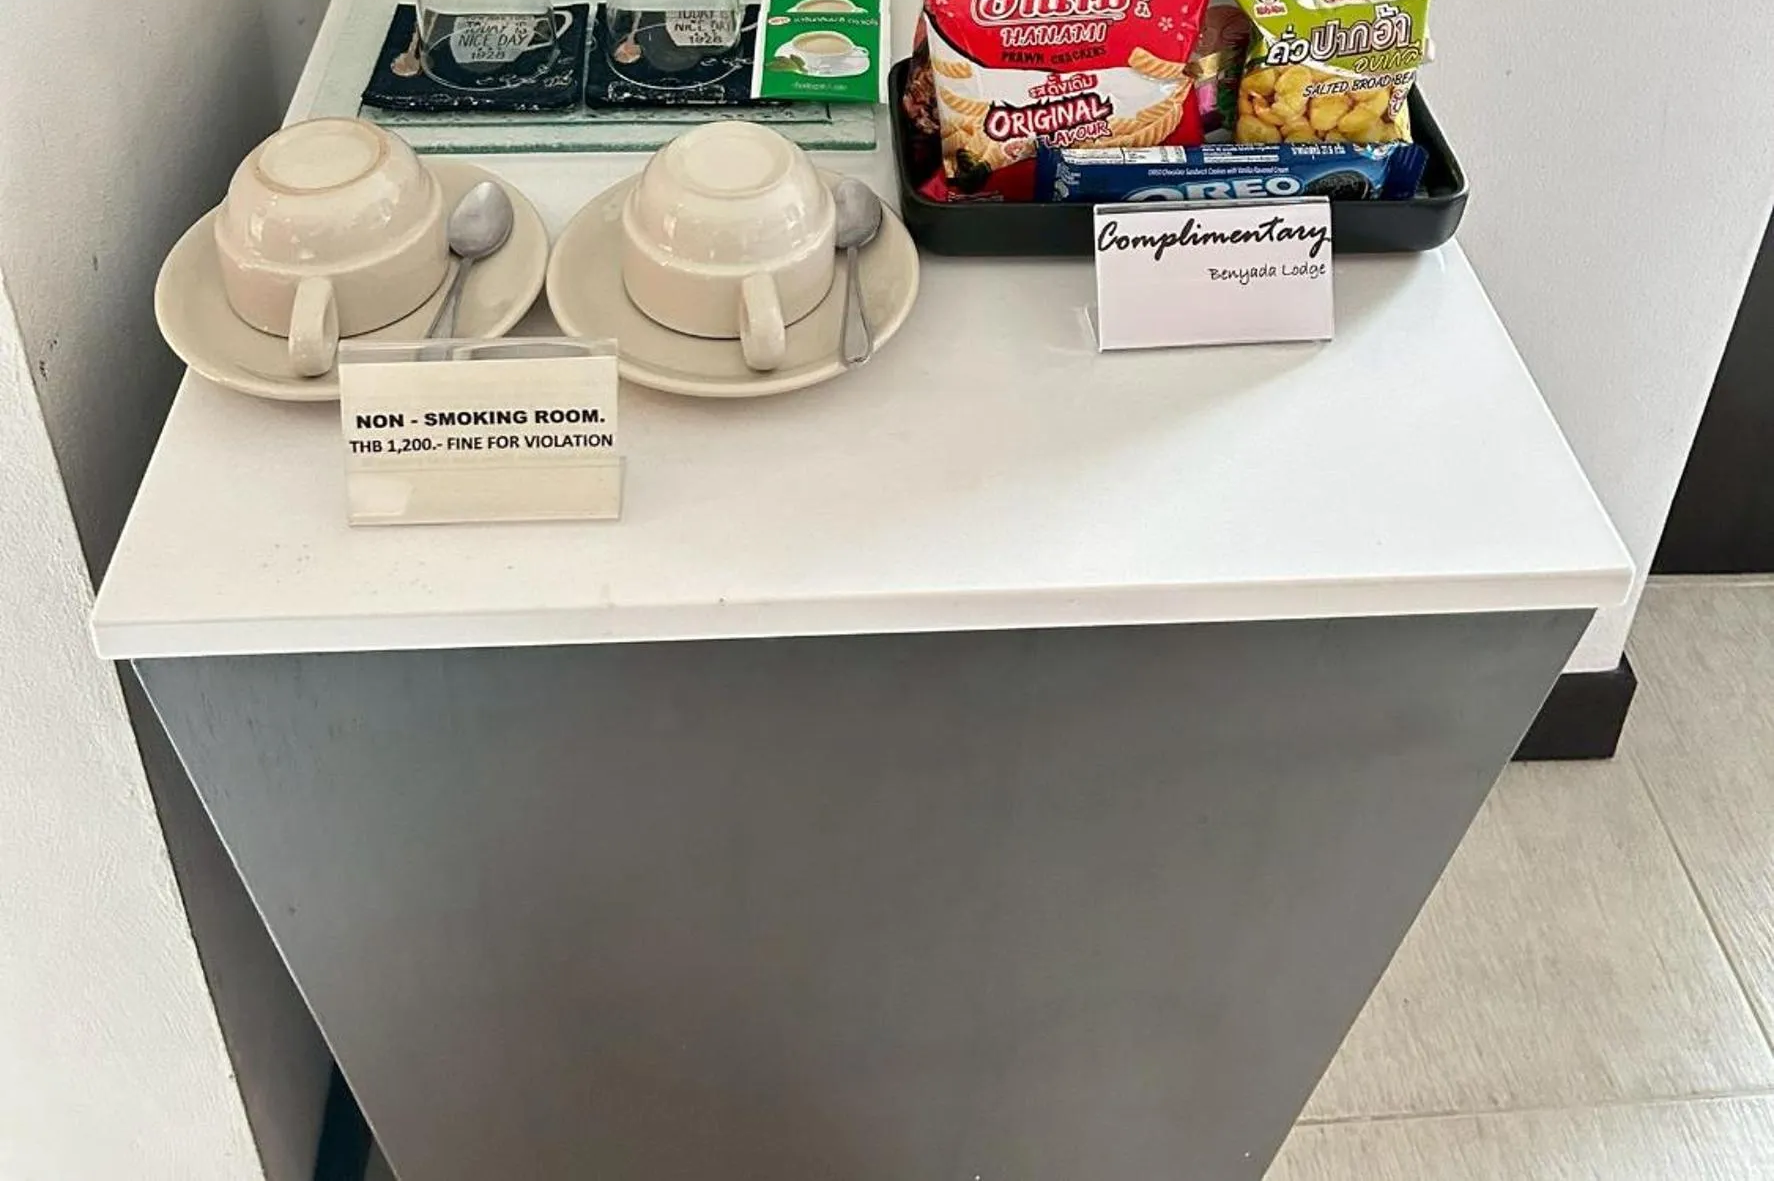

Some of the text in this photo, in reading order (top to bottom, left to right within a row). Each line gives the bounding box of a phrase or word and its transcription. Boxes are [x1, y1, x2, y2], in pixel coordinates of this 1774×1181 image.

[458, 34, 528, 48] NICE DAY
[1000, 22, 1107, 47] HANAMI
[1002, 45, 1107, 64] PRAWN CRACKERS
[1303, 81, 1349, 97] SALTED
[1352, 74, 1391, 91] BROAD
[988, 96, 1109, 138] ORIGINAL
[1097, 216, 1332, 261] Complimentary
[1208, 262, 1326, 285] Benyada Lodge
[356, 413, 405, 429] NON
[424, 410, 528, 427] SMOKING
[535, 409, 606, 425] ROOM.
[350, 433, 613, 455] THB 1,200.- FINE FOR VIOLATION
